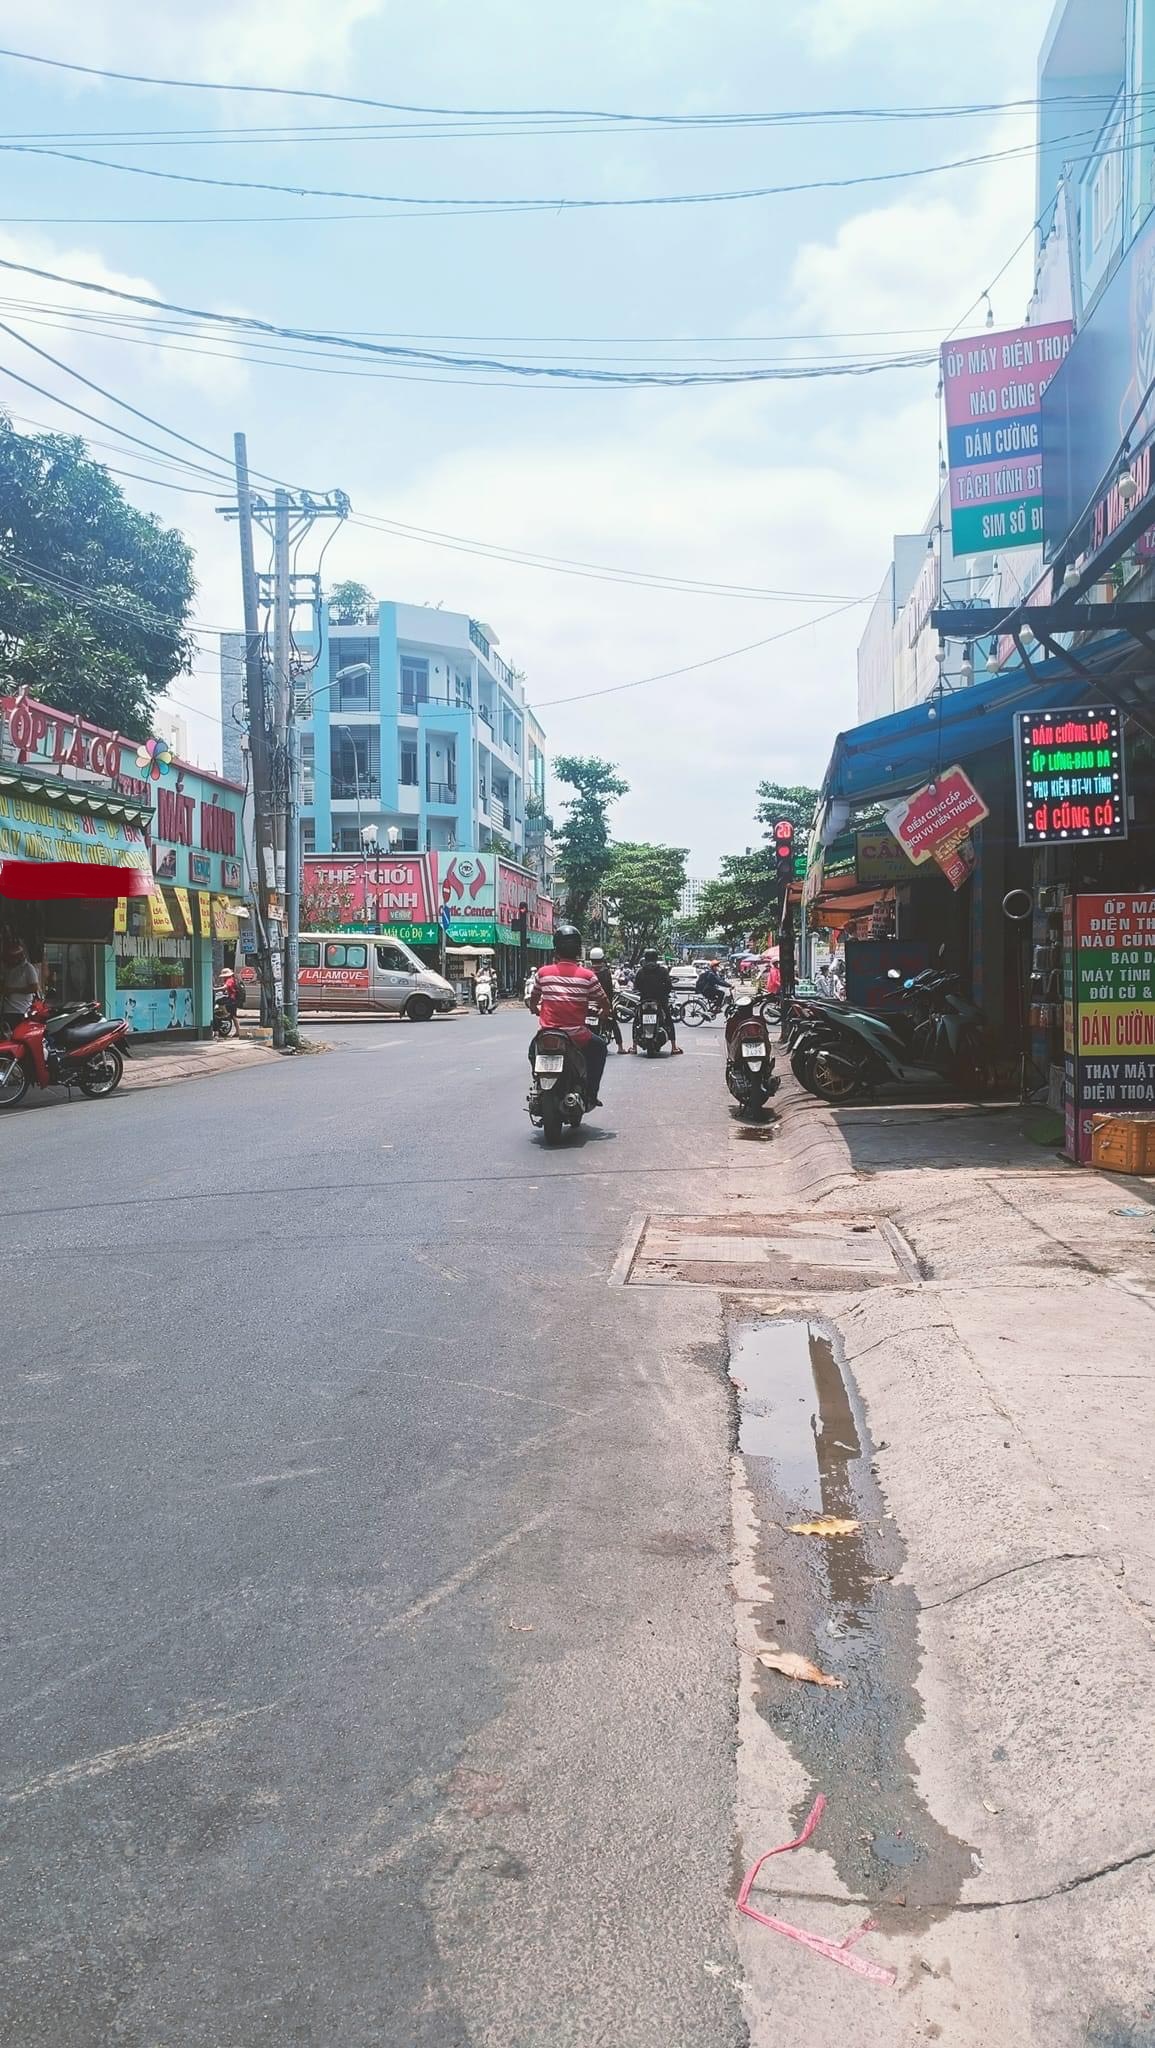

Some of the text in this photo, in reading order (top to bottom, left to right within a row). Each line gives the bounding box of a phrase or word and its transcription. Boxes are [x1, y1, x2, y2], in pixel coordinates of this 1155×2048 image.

[947, 347, 964, 378] ỐP
[968, 344, 997, 375] MÁY
[1002, 338, 1033, 372] ĐIỆN
[969, 385, 997, 416] NÀO
[1001, 379, 1036, 410] CŨNG
[965, 422, 1038, 458] DÁN CƯỜNG
[958, 471, 990, 501] TÁCH
[994, 465, 1023, 495] KÍNH
[982, 512, 1006, 539] SIM
[1009, 502, 1027, 535] SỐ
[1032, 720, 1109, 746] DÁN CƯỜNG LỰC
[1032, 749, 1046, 773] ỐP
[1097, 749, 1111, 768] DA
[1033, 780, 1049, 801] PHỤ
[1051, 776, 1070, 801] KIỆN
[1093, 773, 1112, 794] TÍNH
[157, 771, 196, 847] MẮT
[200, 793, 236, 858] KÍNH
[906, 791, 961, 833] ĐIỂM CUNG CẤP
[921, 824, 934, 837] VỤ
[931, 814, 952, 829] VIỄN
[950, 795, 977, 817] THÔNG
[1035, 799, 1113, 831] GÌ CŨNG CÓ
[314, 863, 414, 885] THẾ GIỚI
[464, 904, 496, 917] Center
[1104, 898, 1126, 914] ỐP
[1090, 916, 1130, 934] ĐIỆN
[1111, 951, 1139, 965] BAO
[306, 971, 365, 980] LALAMOVE
[1081, 966, 1151, 982] MÁY TÍNH
[1089, 984, 1152, 1000] ĐỜI CŨ &
[1081, 1009, 1111, 1046] DÁN
[1085, 1061, 1155, 1081] THAY MẶT
[1083, 1082, 1115, 1103] ĐIỆN
